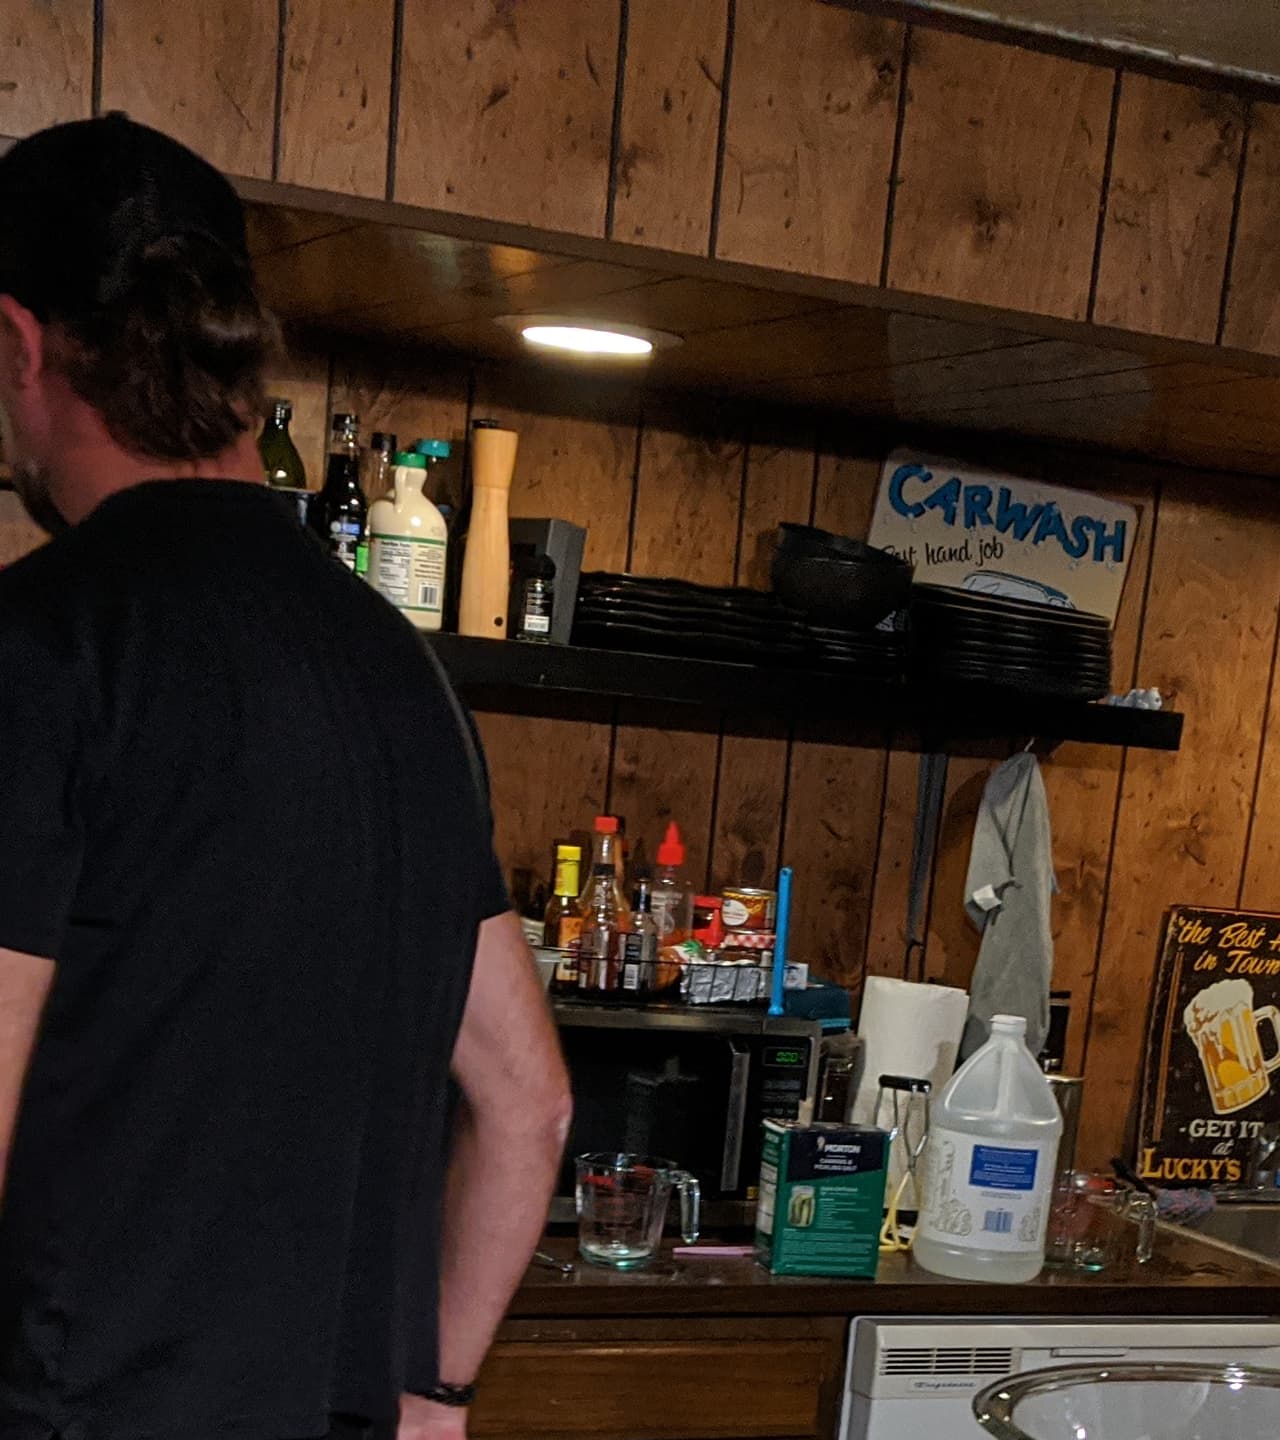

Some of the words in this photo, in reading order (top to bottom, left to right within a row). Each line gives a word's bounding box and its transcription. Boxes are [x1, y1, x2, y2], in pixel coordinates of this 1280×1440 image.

[888, 464, 1127, 562] CARWASH
[925, 539, 973, 565] hand
[975, 535, 1004, 567] job
[1218, 922, 1266, 948] Best
[825, 1144, 861, 1153] MORTON
[1212, 1139, 1234, 1156] at
